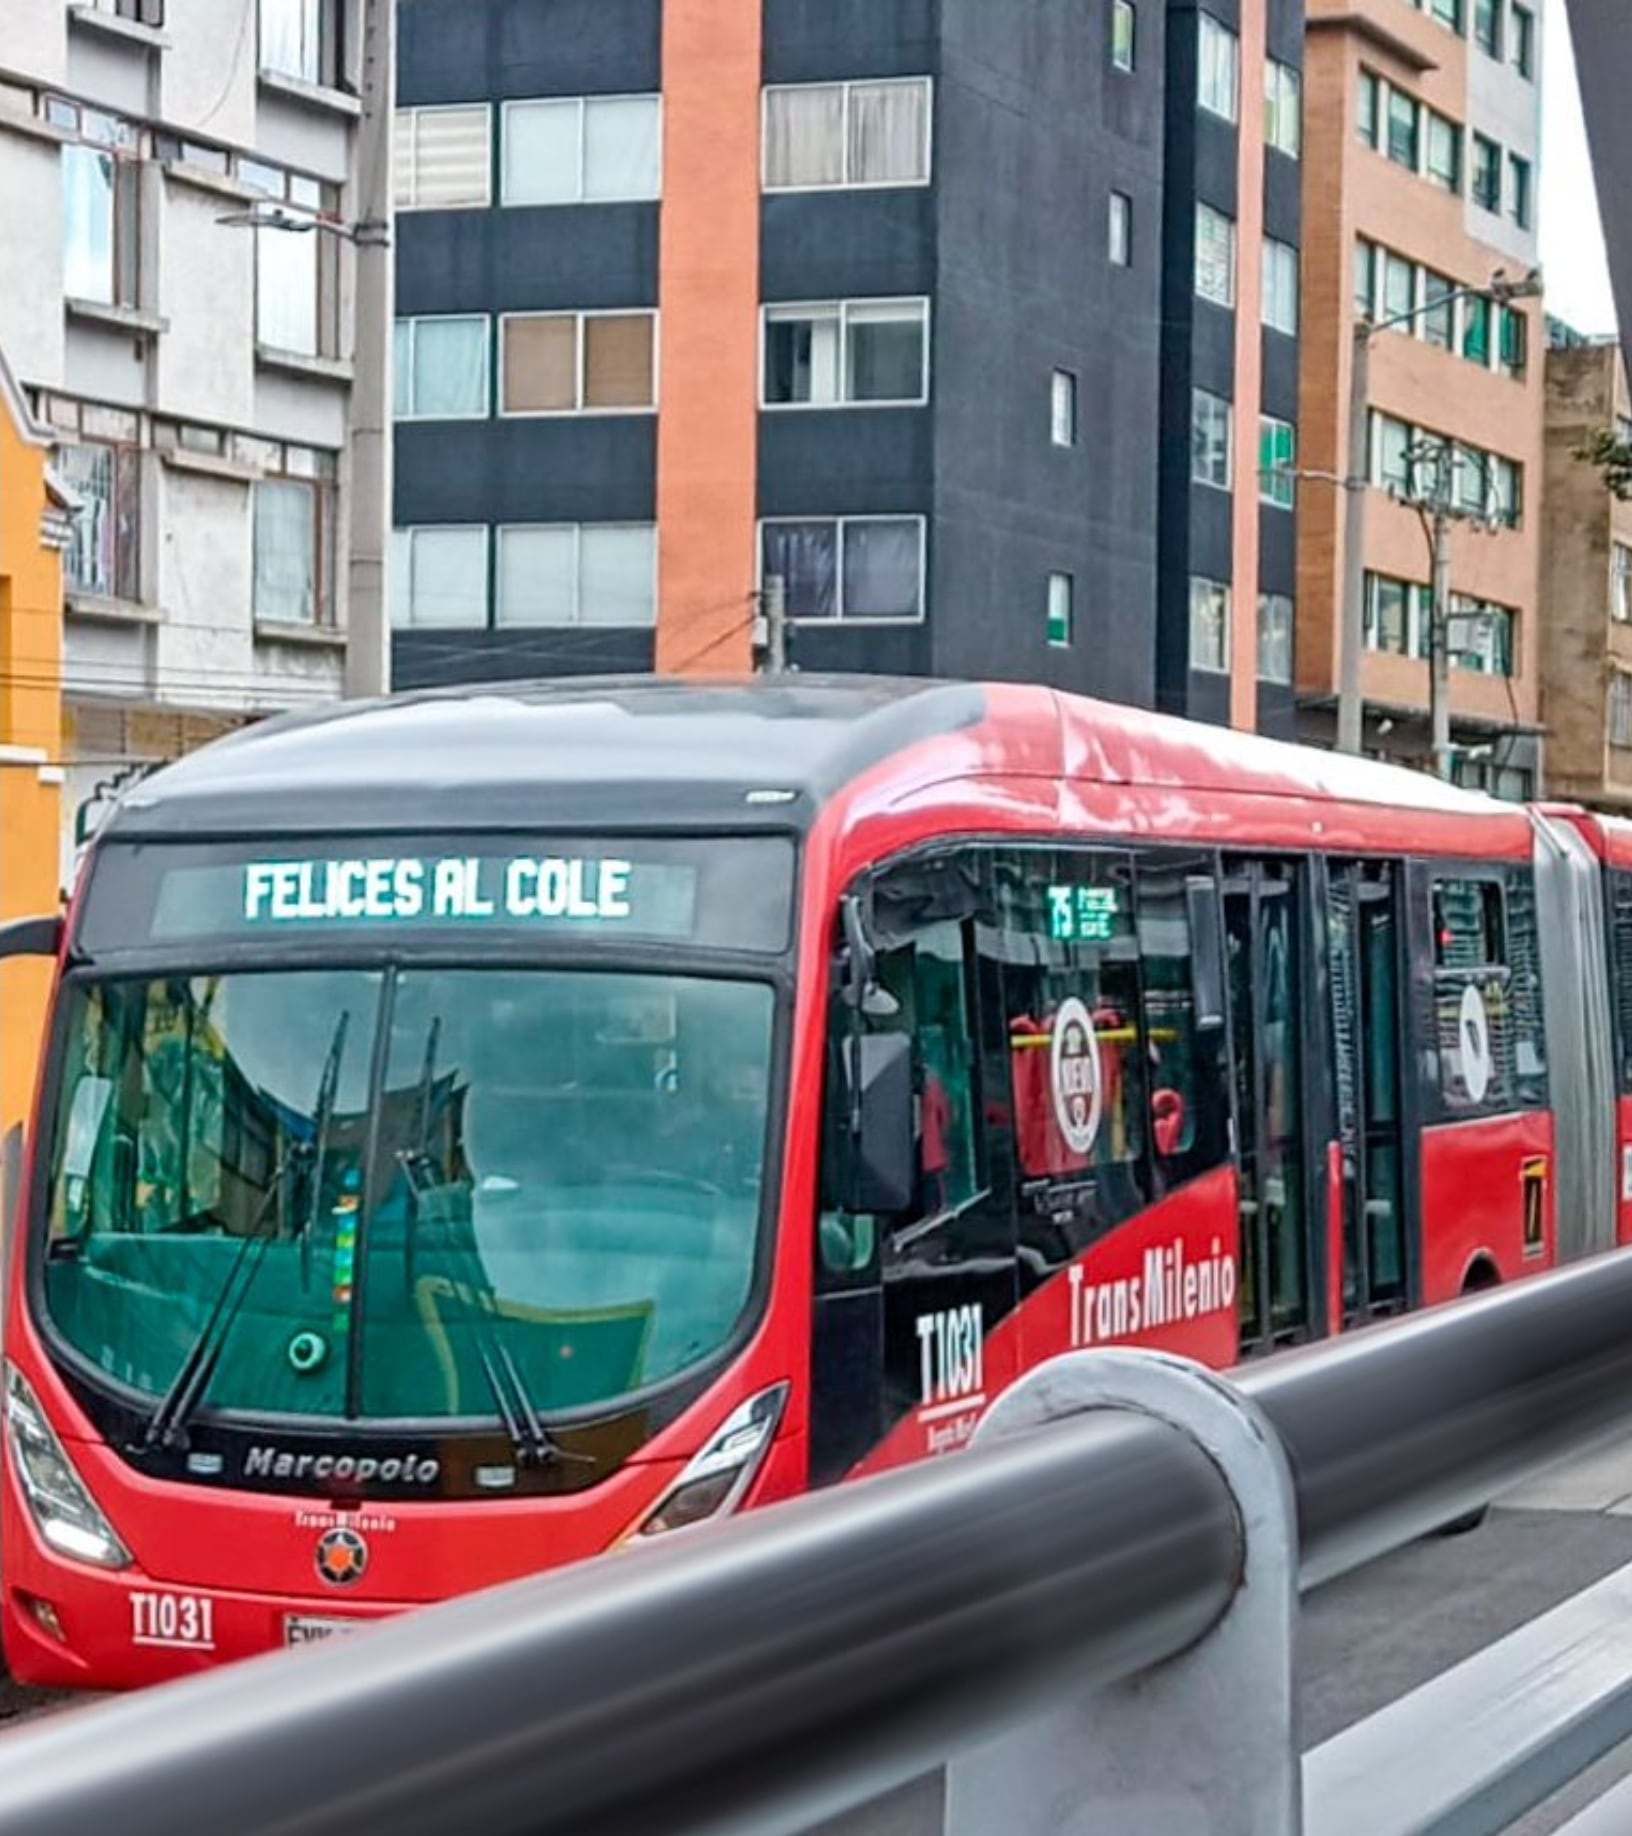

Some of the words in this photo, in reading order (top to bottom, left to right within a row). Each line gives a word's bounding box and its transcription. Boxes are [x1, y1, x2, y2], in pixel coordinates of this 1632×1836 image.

[245, 859, 424, 919] FELICES
[433, 858, 495, 916] AL
[506, 859, 631, 917] COLE
[1068, 1236, 1236, 1347] TransMilenio
[916, 1303, 983, 1405] T1031
[244, 1447, 439, 1483] Marcopolo
[129, 1592, 212, 1641] T1031
